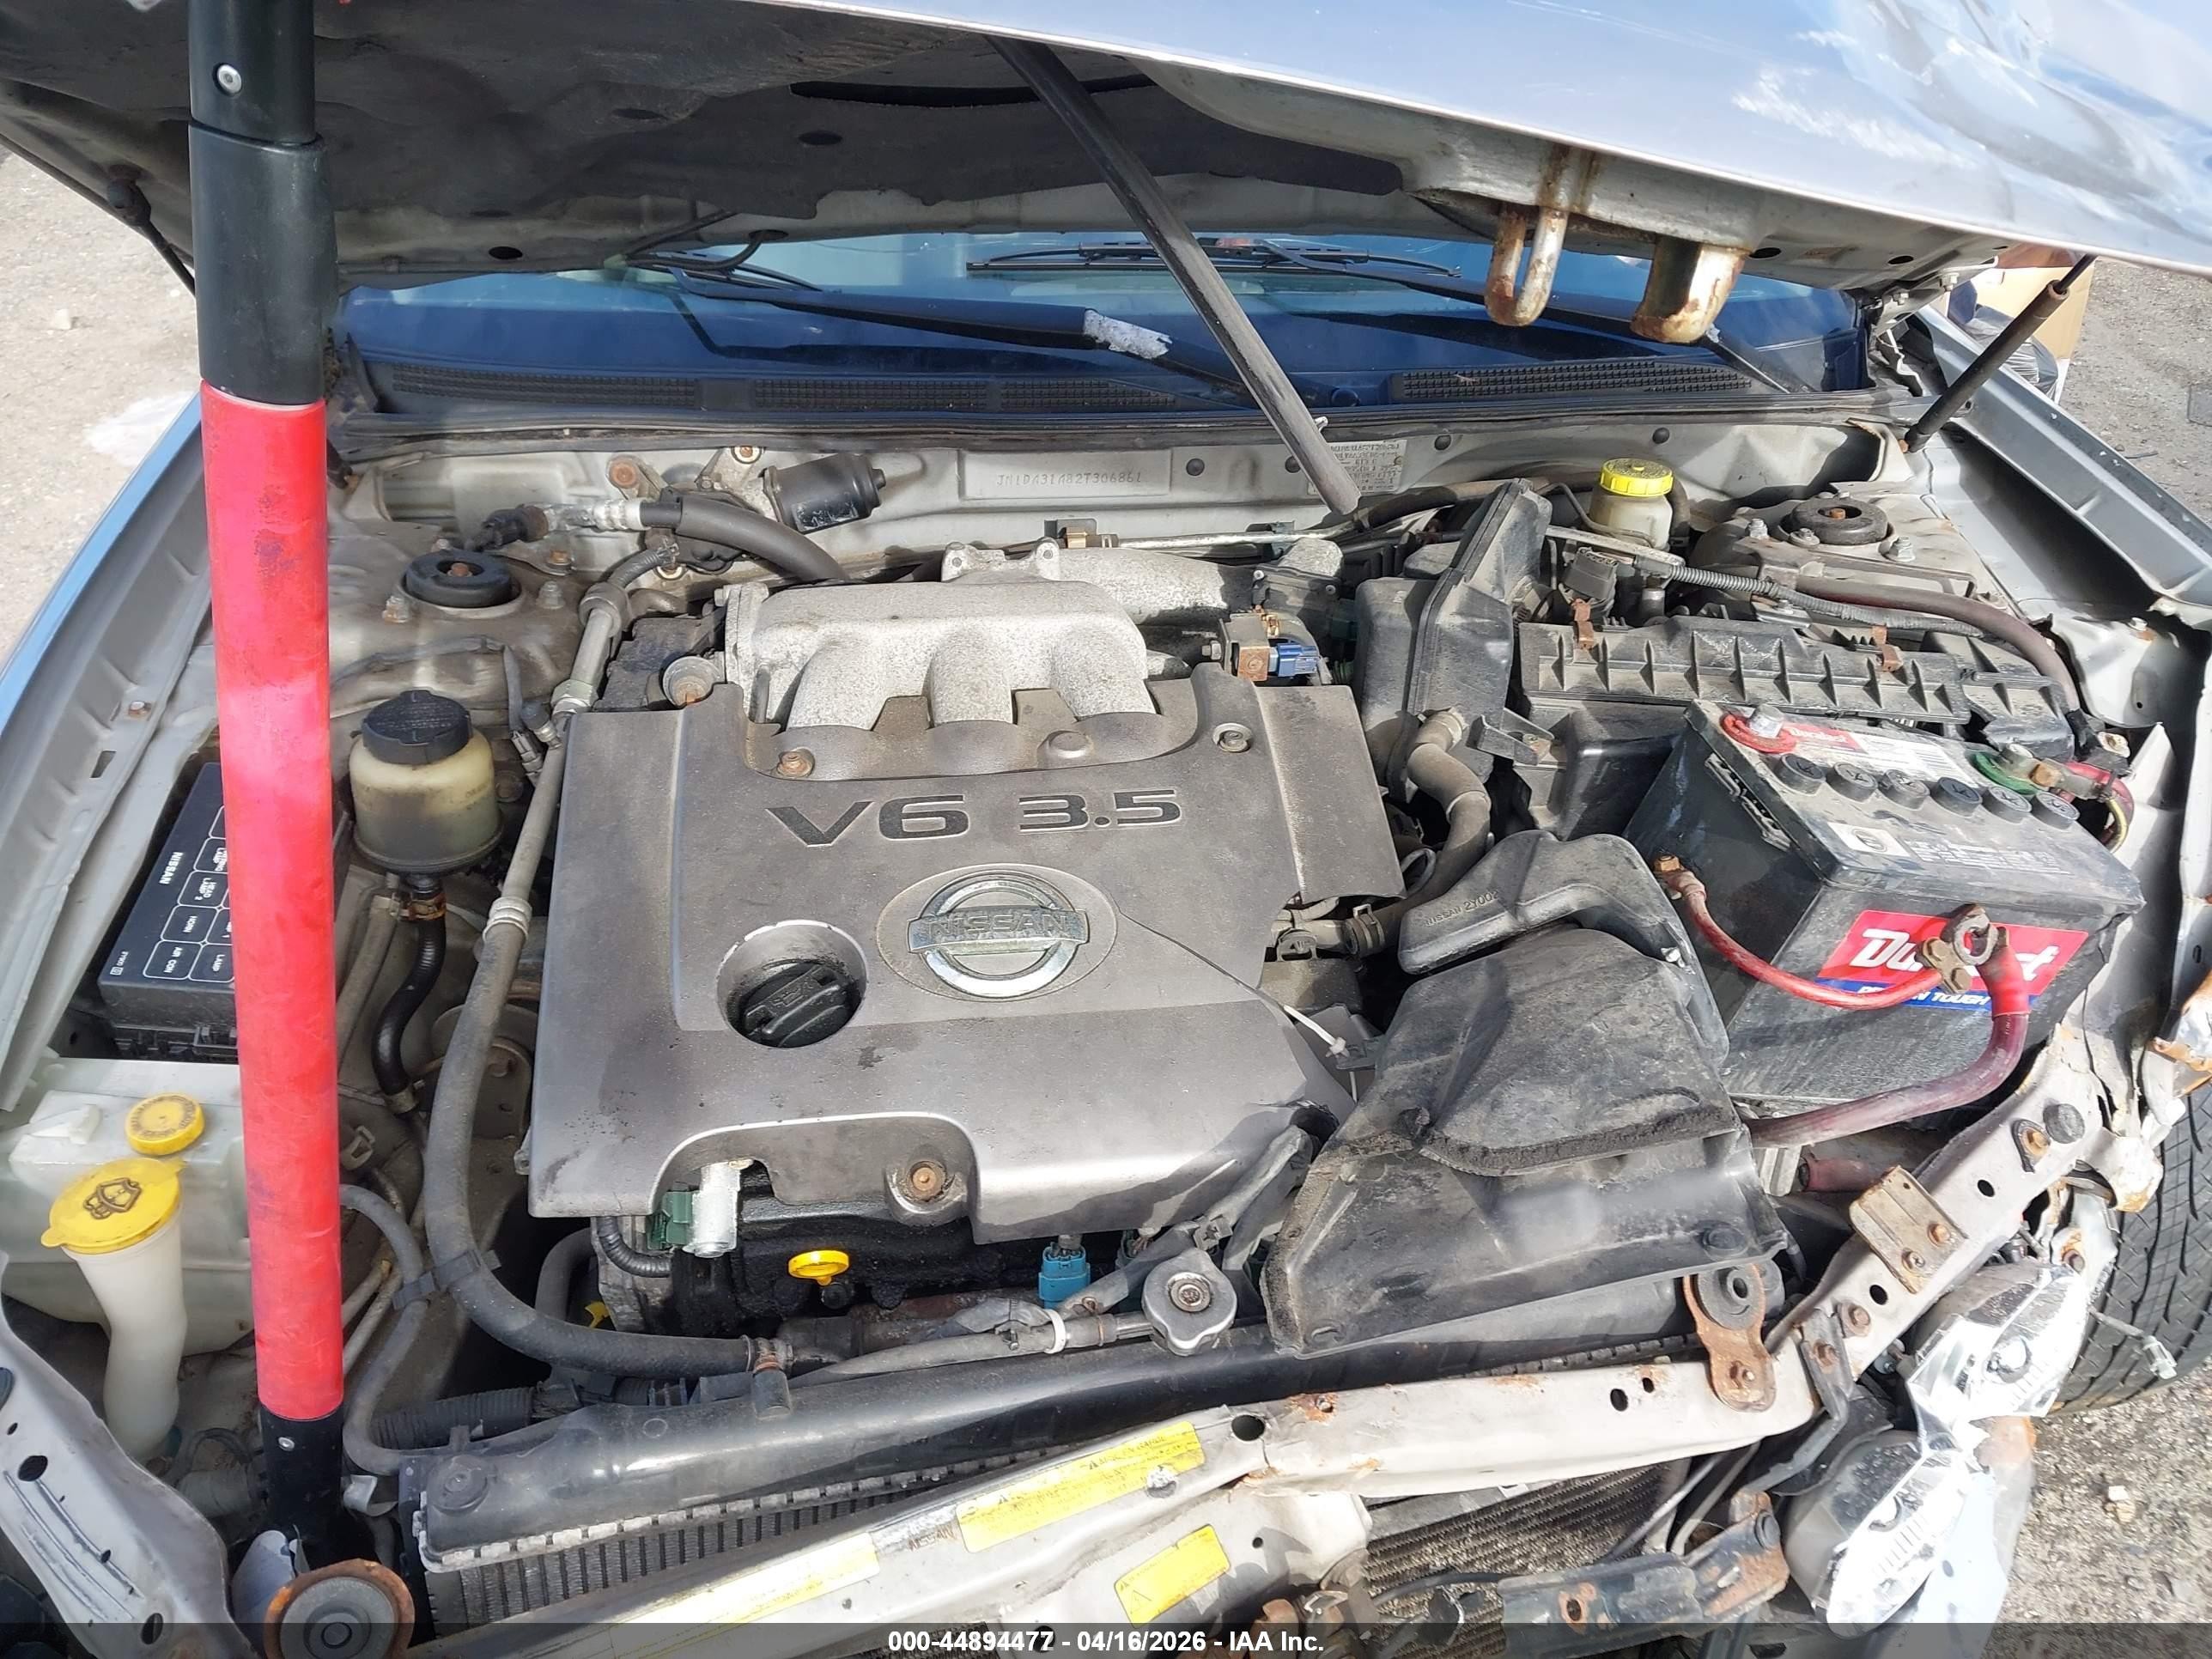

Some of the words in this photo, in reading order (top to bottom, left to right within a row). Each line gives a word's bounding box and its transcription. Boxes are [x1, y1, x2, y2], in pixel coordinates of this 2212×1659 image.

[767, 793, 970, 848] V6
[1018, 788, 1182, 834] 3.5
[159, 851, 184, 884] NISSAN
[182, 915, 198, 933] HORN
[928, 914, 1069, 938] NISSAN
[172, 946, 184, 958] AIR
[162, 958, 178, 974] CON
[1932, 992, 1991, 1006] TOUGH
